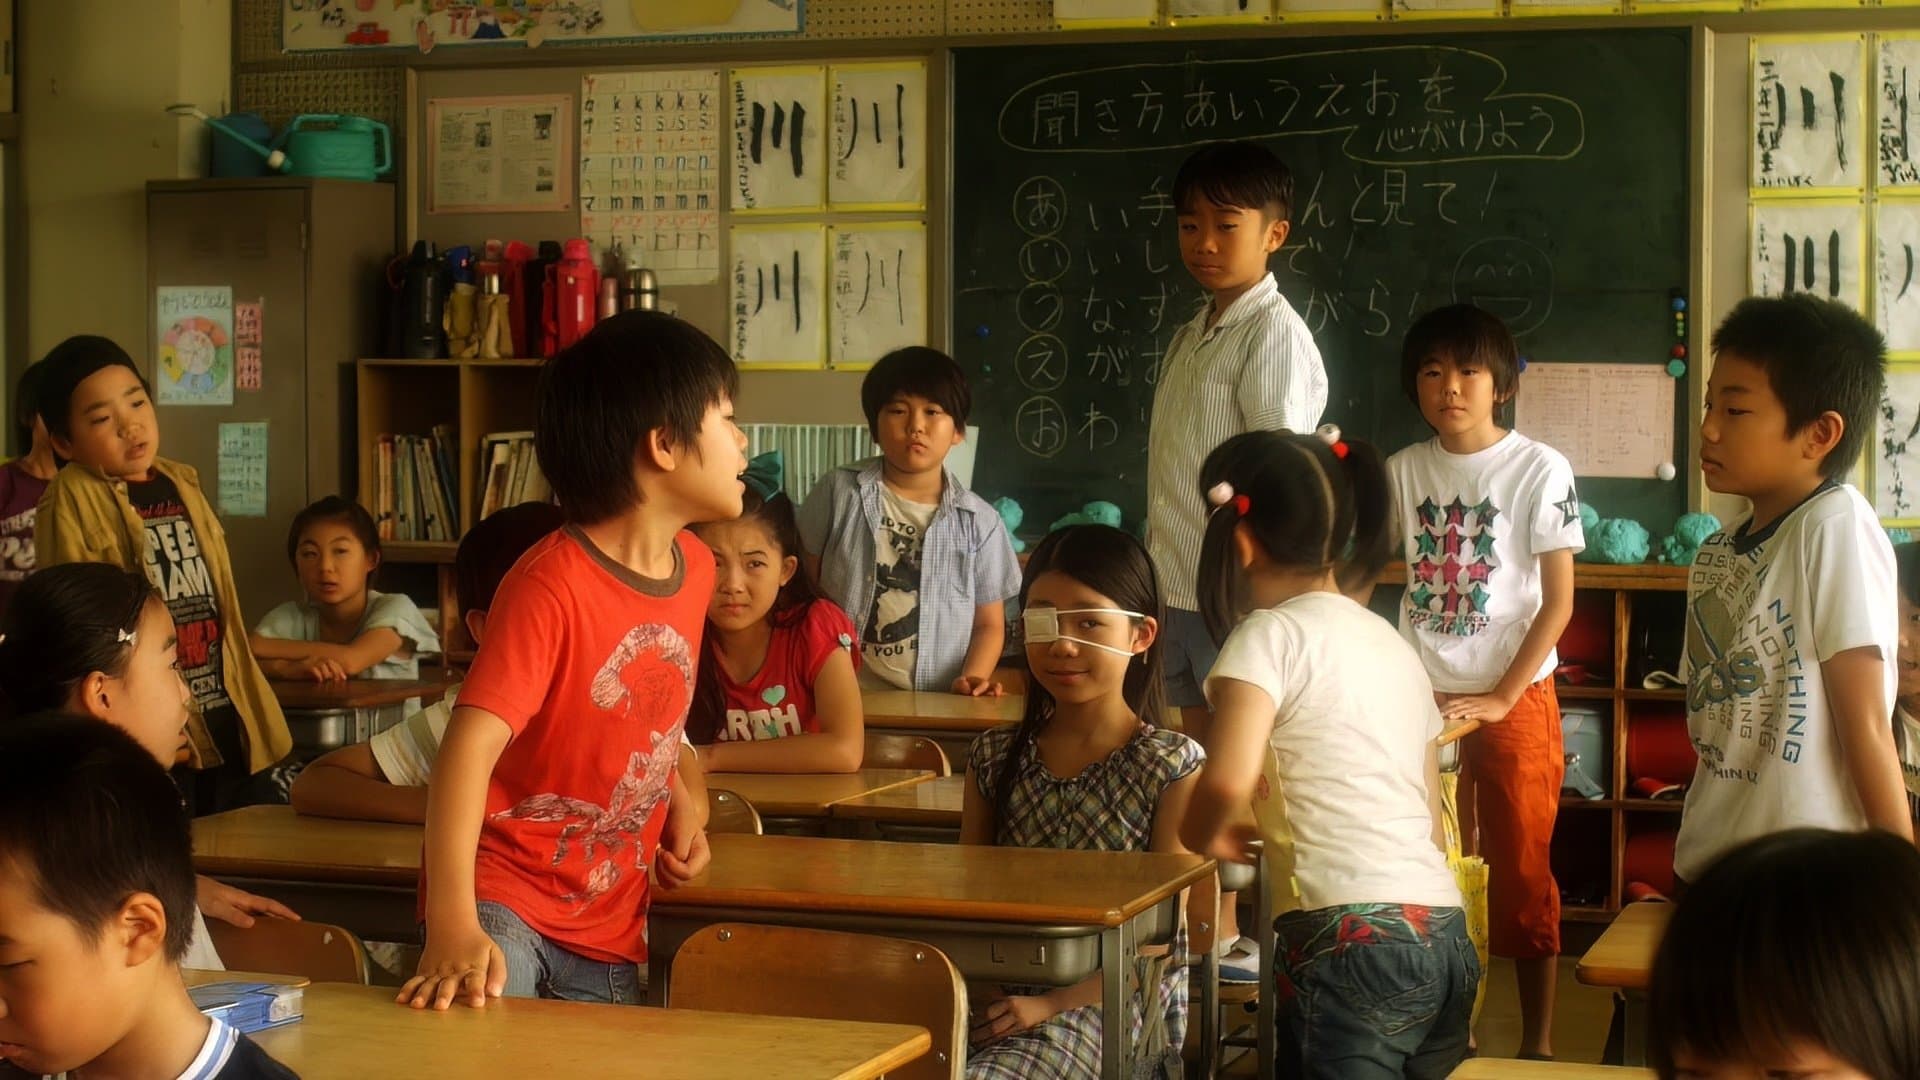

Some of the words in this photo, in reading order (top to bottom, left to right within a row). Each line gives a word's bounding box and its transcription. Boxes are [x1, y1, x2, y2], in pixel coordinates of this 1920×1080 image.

[1375, 106, 1555, 154] 心がけよう
[874, 645, 904, 657] YOU
[1766, 597, 1807, 764] NOTHING
